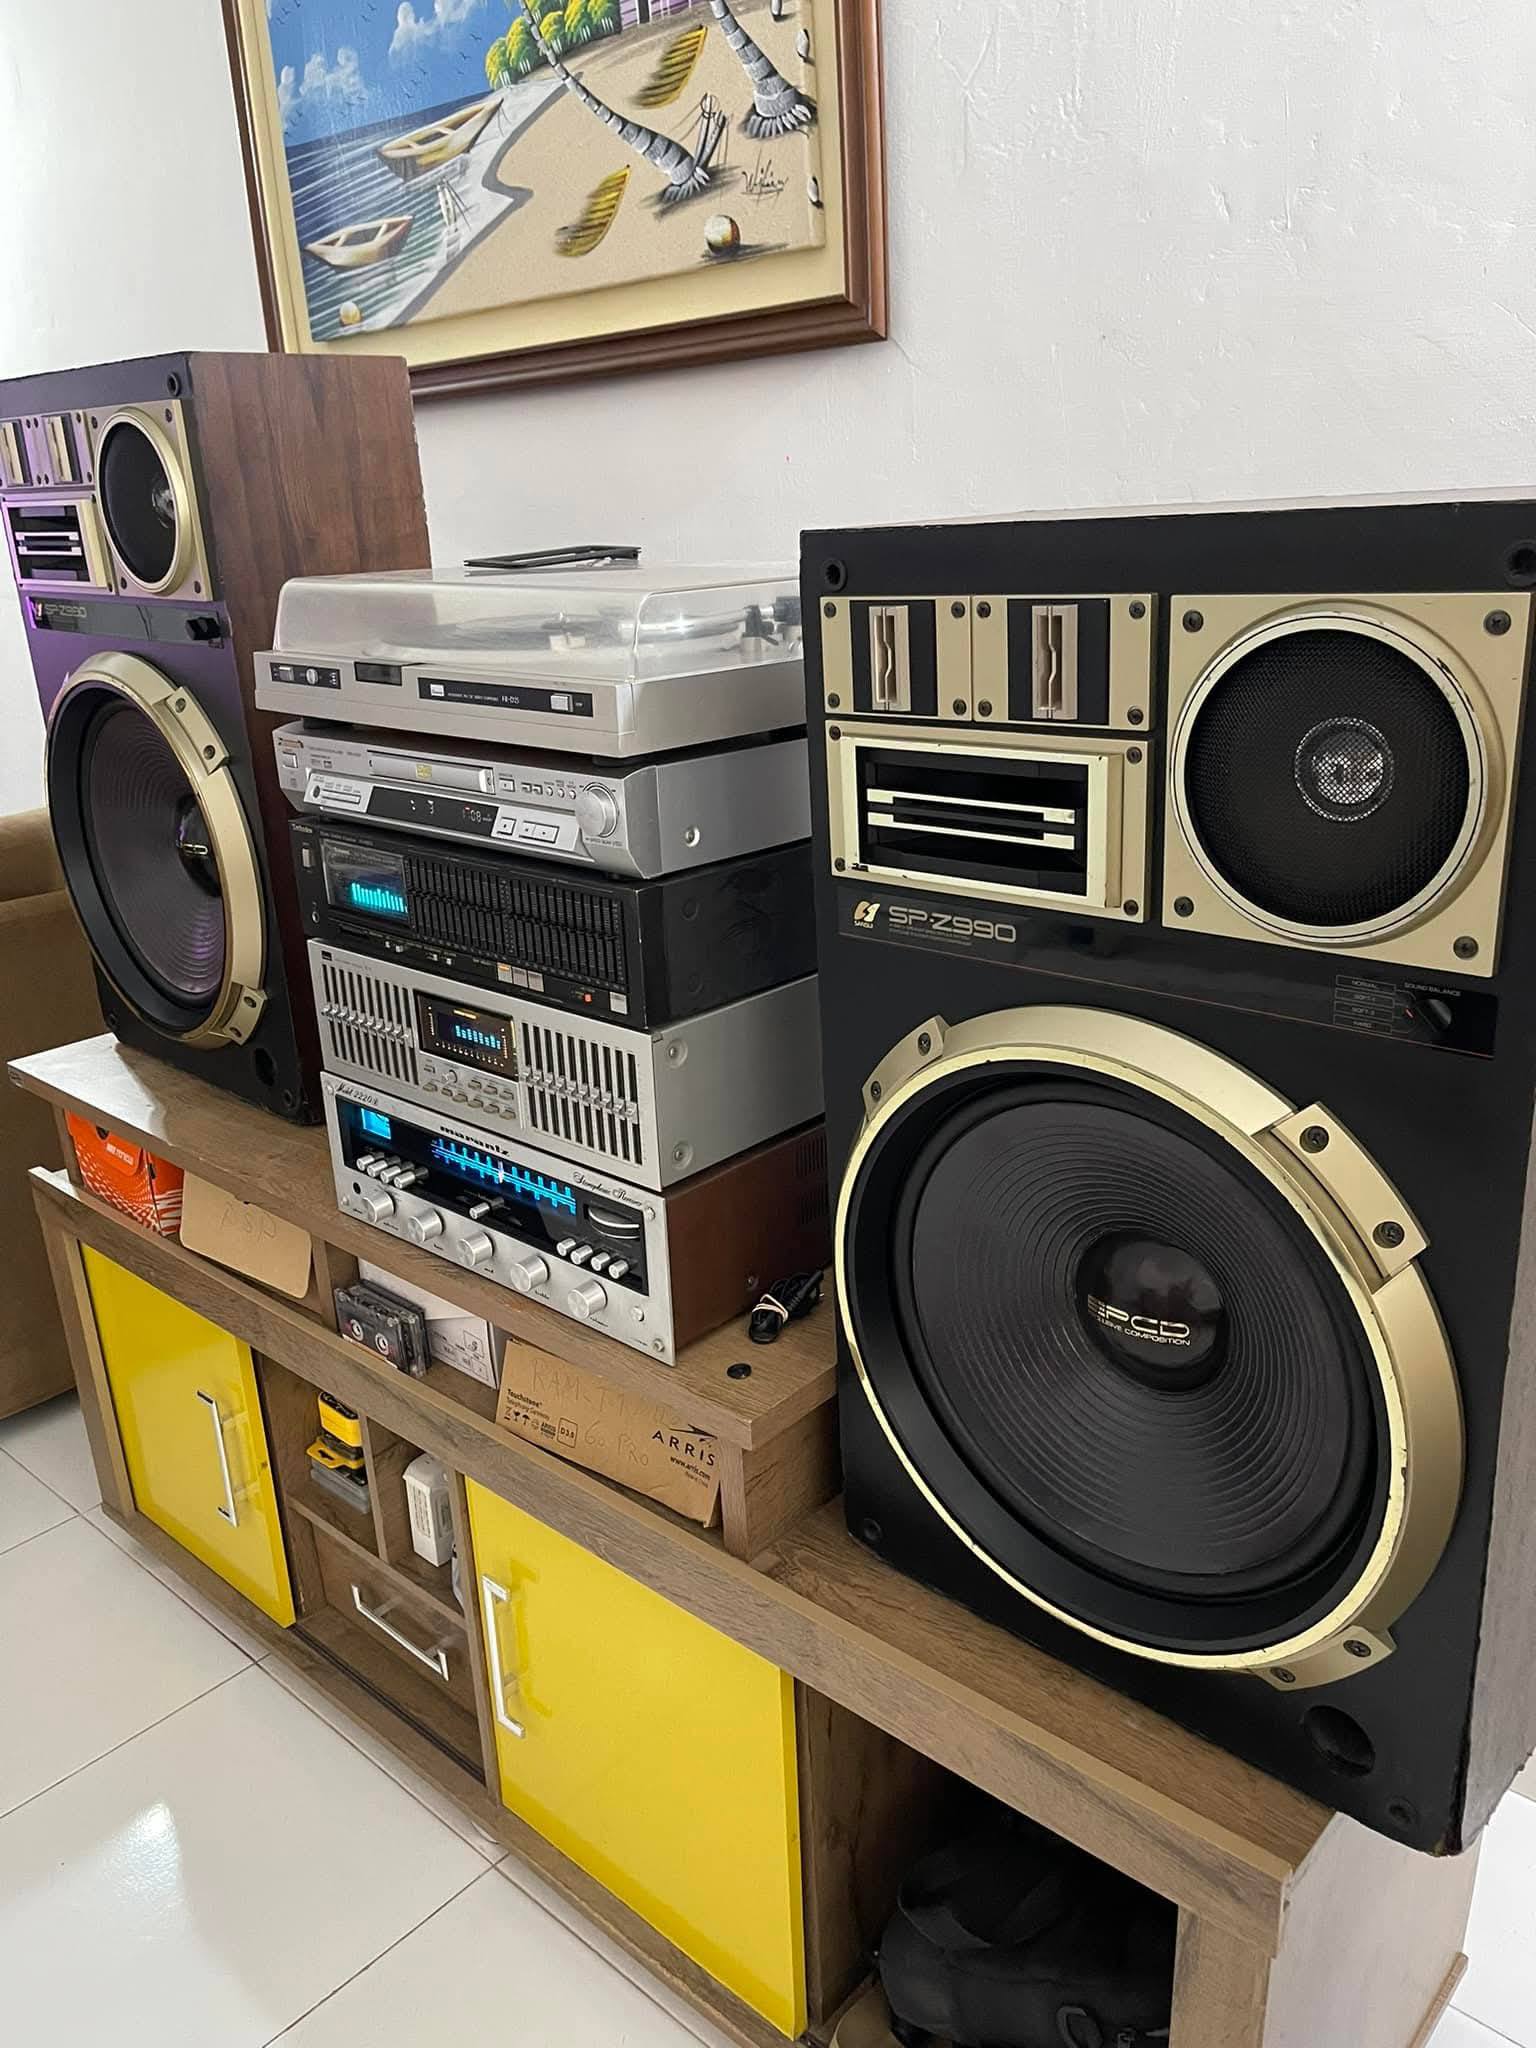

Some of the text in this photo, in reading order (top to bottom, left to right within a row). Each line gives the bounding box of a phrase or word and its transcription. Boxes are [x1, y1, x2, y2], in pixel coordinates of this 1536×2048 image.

[440, 1125, 510, 1156] marantz
[1124, 1328, 1191, 1346] COMPOSITION
[651, 1430, 716, 1466] ARRIS
[670, 1455, 711, 1481] www.arris.com
